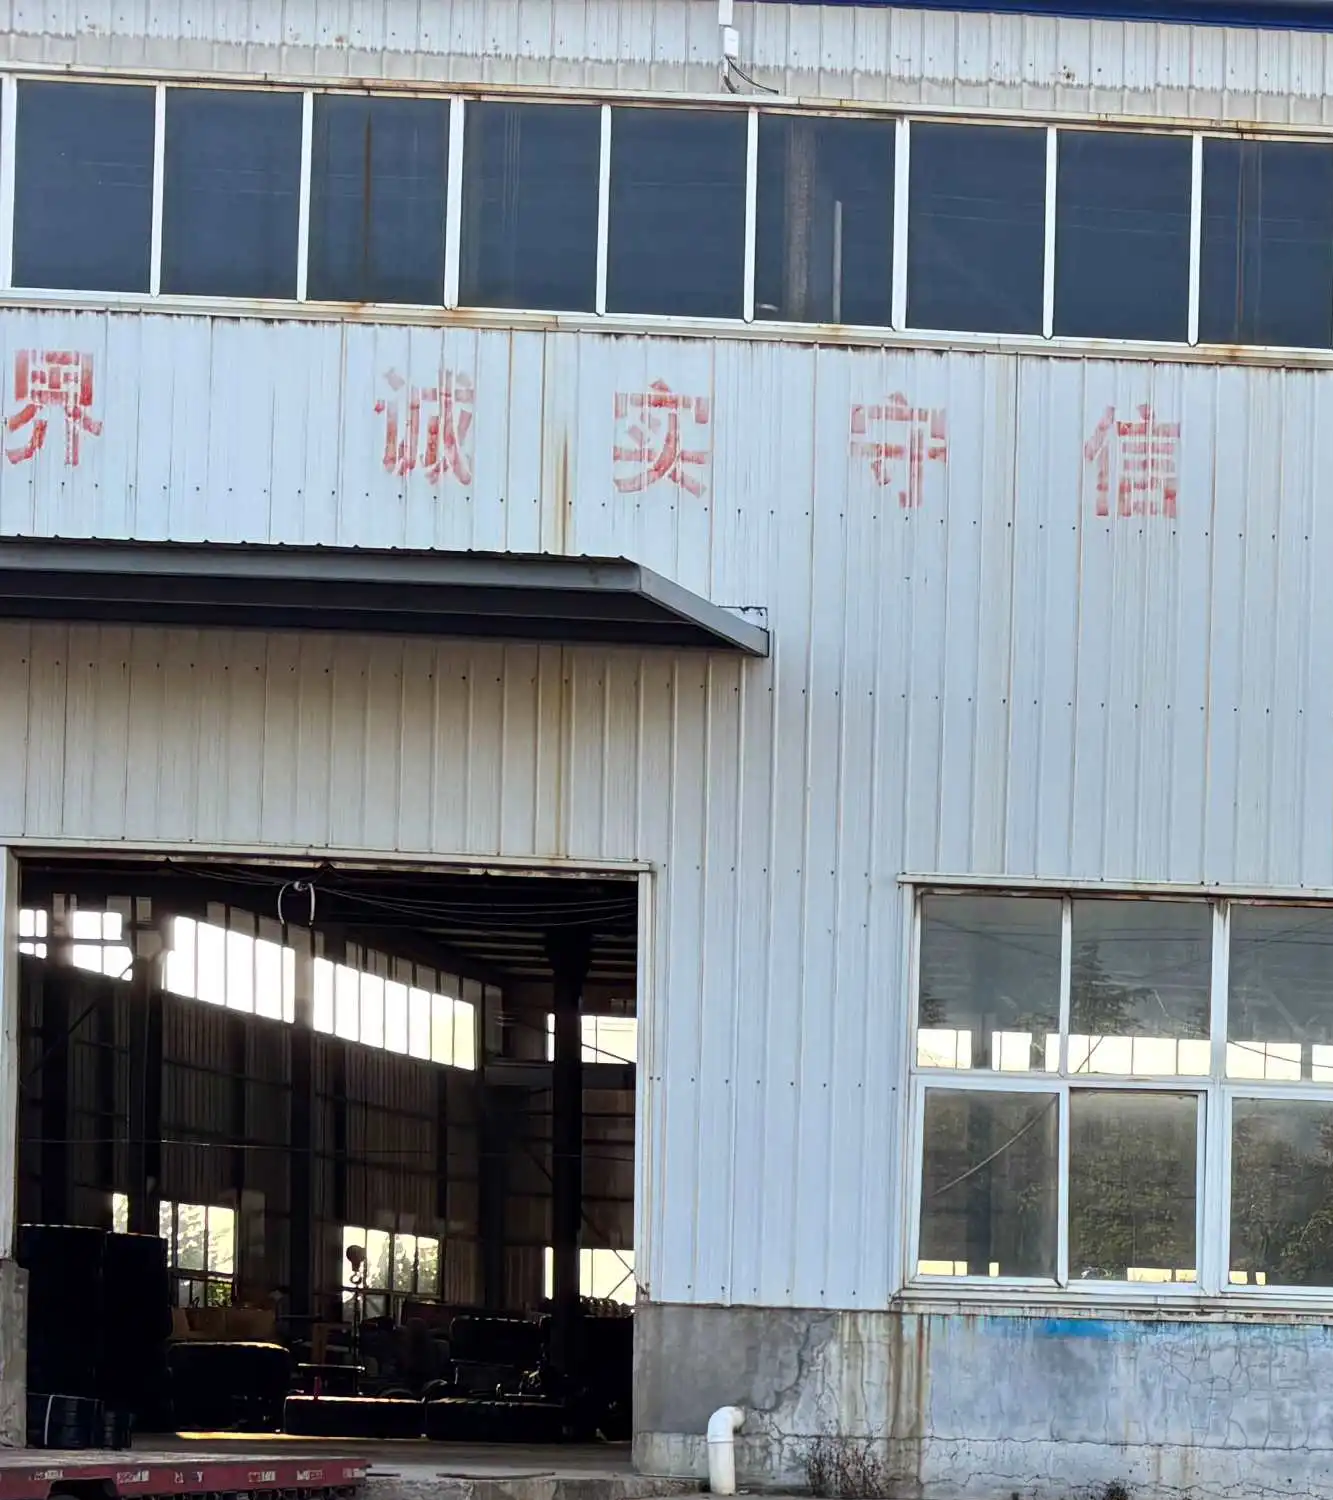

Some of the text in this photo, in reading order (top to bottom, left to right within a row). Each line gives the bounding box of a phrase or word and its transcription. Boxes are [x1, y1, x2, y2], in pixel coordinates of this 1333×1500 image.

[5, 348, 103, 467] 界
[374, 366, 1181, 519] 诚实守信
